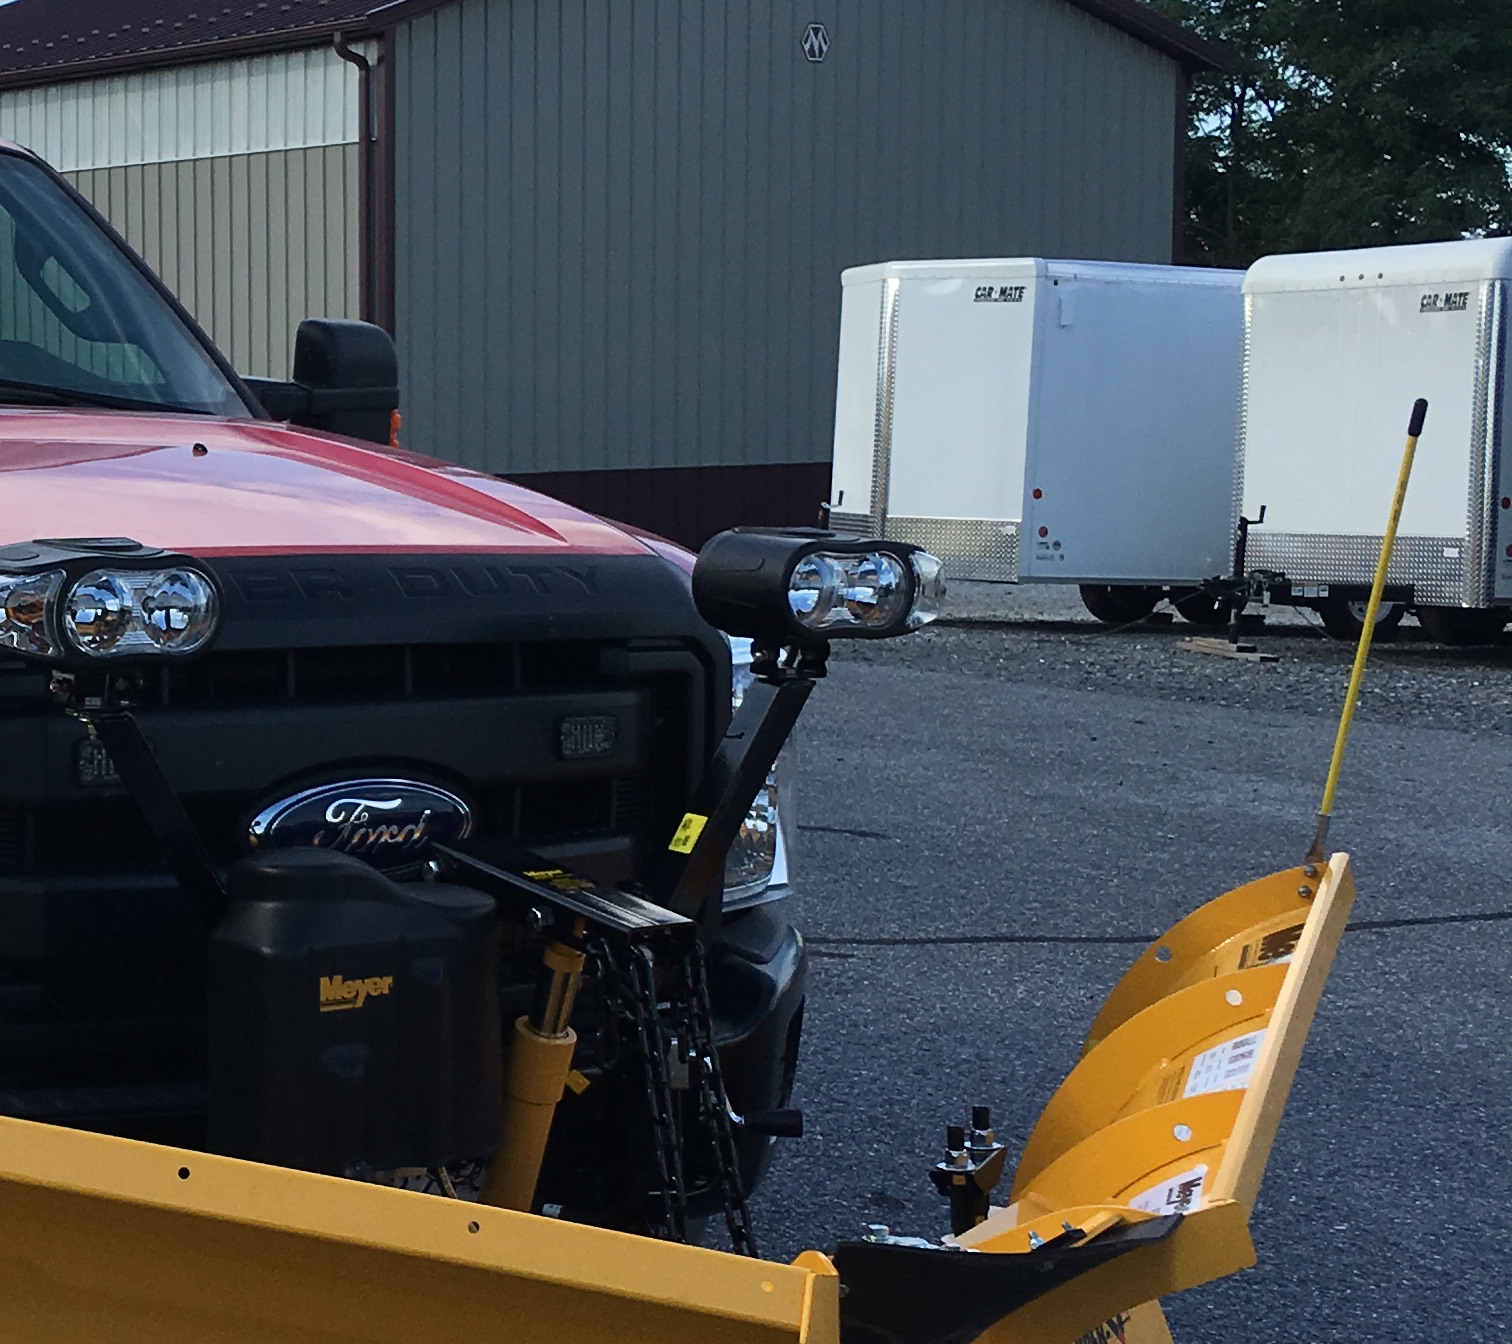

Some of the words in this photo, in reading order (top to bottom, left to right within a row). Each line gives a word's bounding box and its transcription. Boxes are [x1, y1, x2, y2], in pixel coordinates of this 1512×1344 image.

[388, 565, 600, 599] DUTY
[313, 798, 431, 854] Ford
[319, 975, 393, 1010] Meyer
